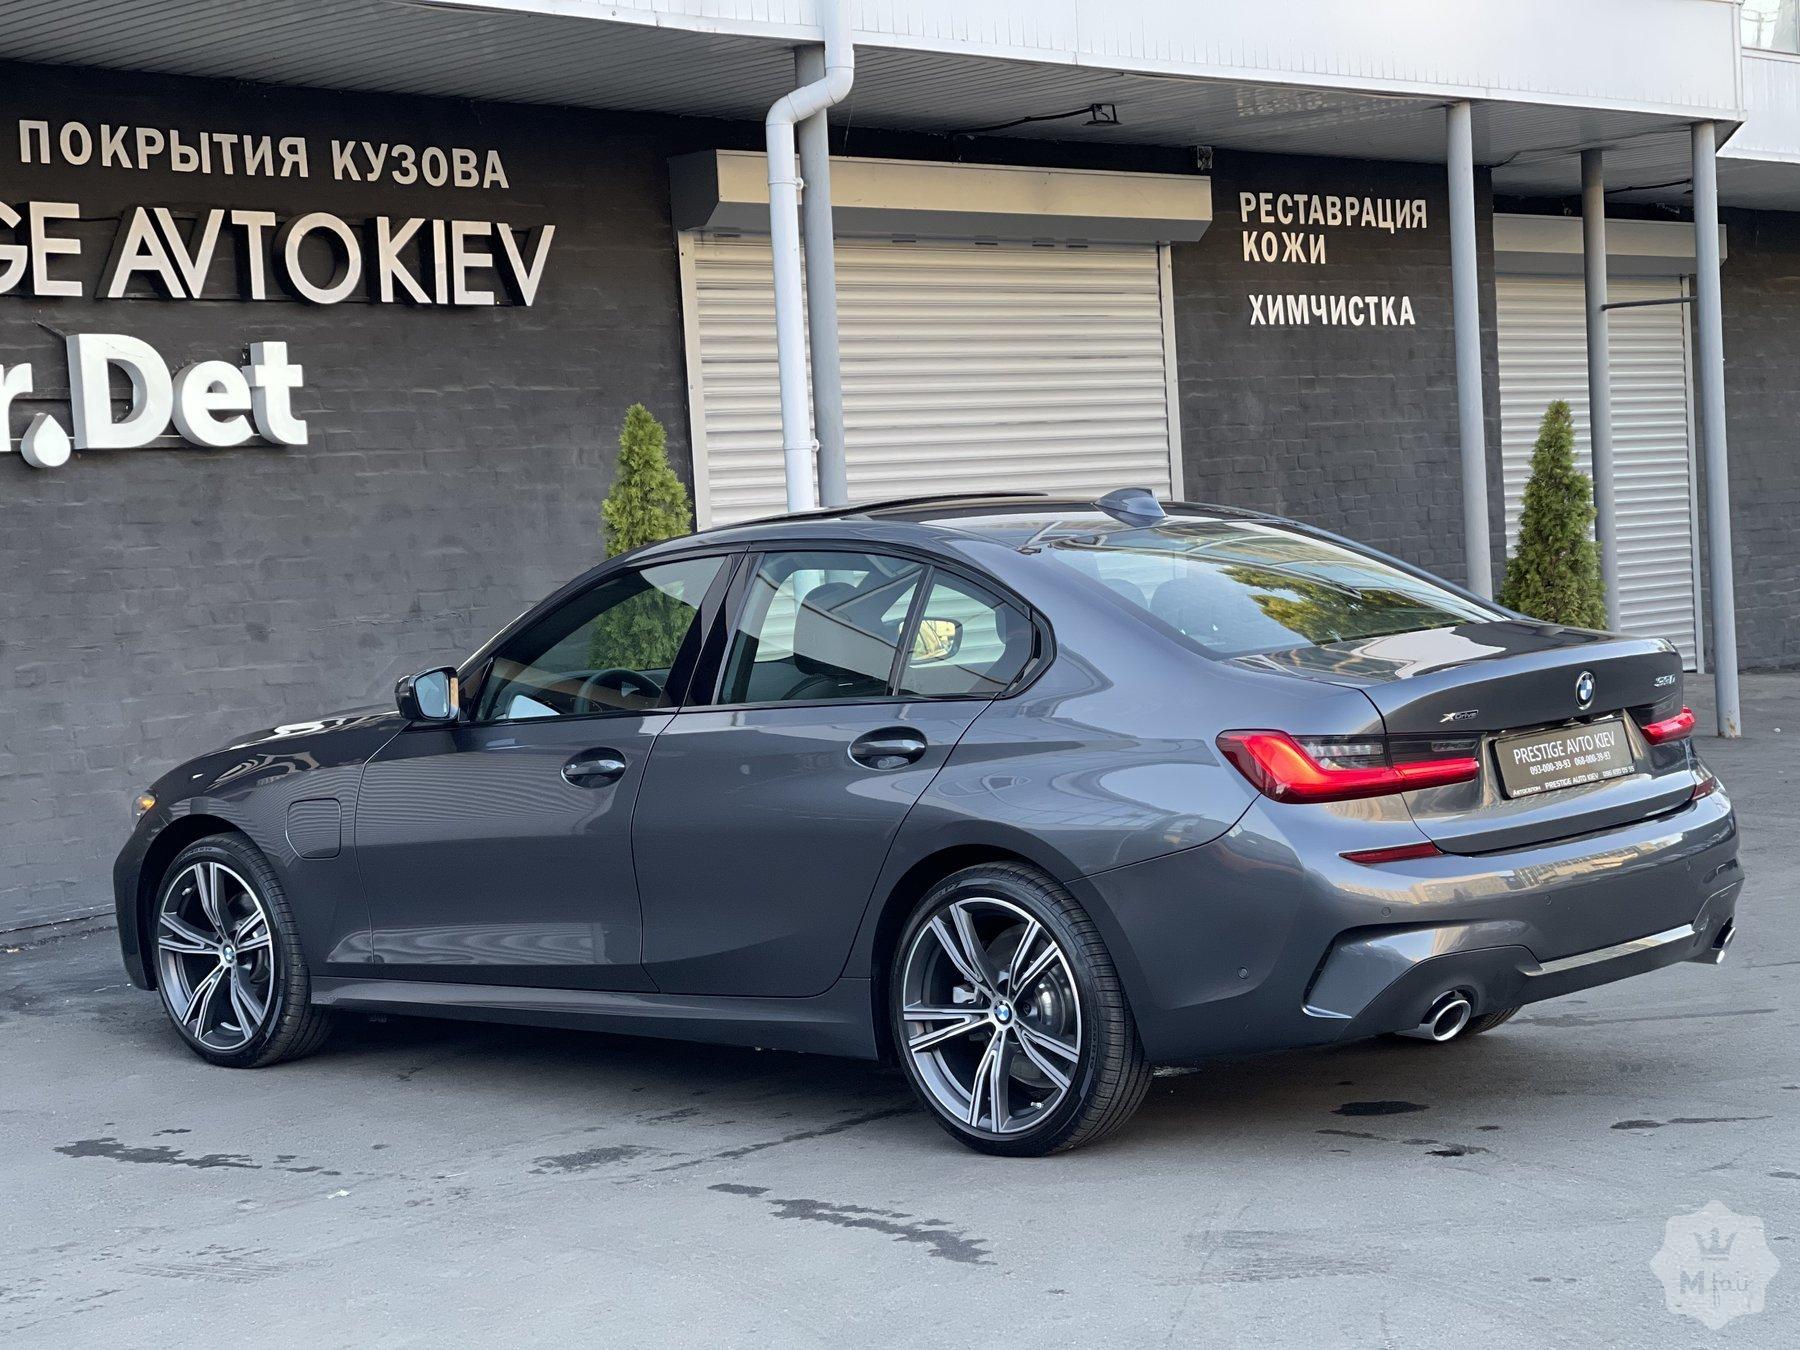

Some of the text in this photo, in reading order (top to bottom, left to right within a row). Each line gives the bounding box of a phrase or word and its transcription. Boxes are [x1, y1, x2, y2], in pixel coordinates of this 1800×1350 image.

[18, 120, 509, 189] ПОКРЫТИЯ КУЗОВА
[1239, 192, 1427, 234] РЕСТАВРАЦИЯ
[1242, 231, 1326, 264] КОЖИ
[1249, 294, 1416, 326] ХИМЧИСТКА
[1513, 731, 1615, 765] PRESTIGE AVTO KIEV
